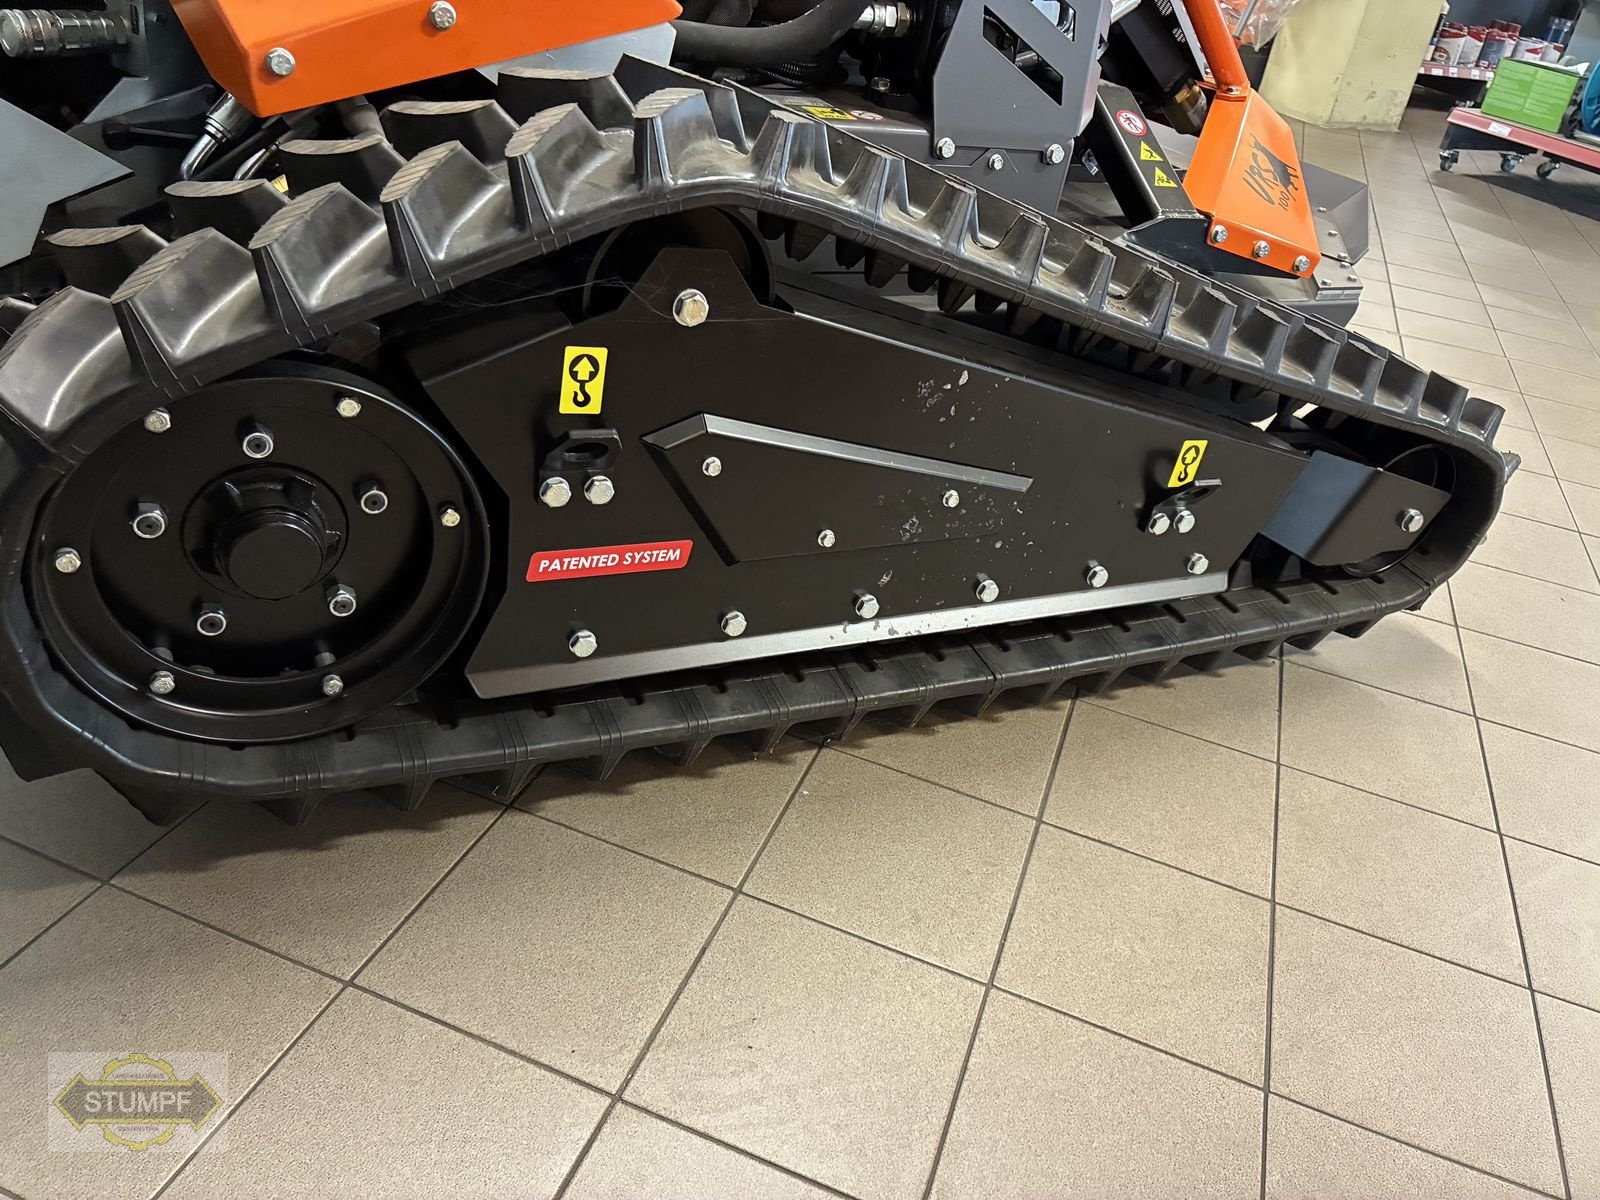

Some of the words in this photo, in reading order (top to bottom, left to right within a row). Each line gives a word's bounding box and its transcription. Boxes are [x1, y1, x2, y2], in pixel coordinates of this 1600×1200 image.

[1278, 191, 1290, 211] 100
[538, 554, 619, 573] PATENTED
[623, 548, 681, 565] SYSTEM
